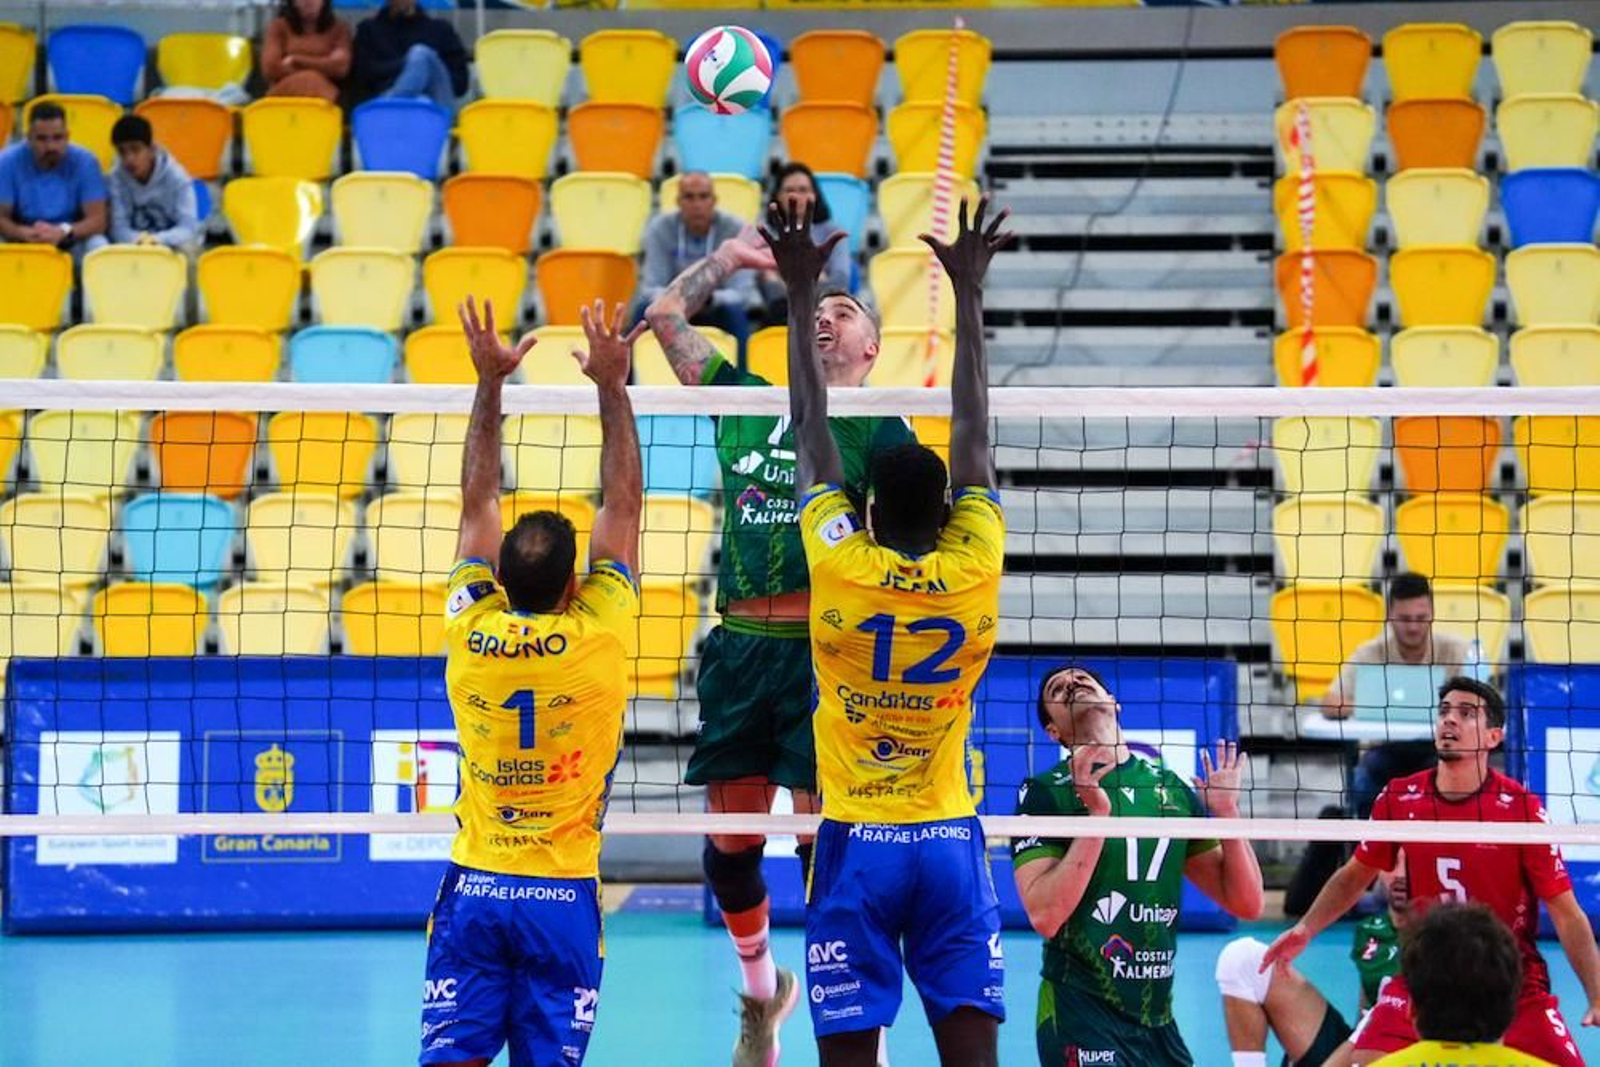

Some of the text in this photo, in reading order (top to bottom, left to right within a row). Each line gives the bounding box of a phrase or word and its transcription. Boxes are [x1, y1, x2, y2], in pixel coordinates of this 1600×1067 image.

[468, 631, 567, 659] BRUNO
[856, 613, 966, 685] 12
[501, 689, 535, 750] 1
[497, 758, 545, 774] Islas
[214, 835, 330, 853] Gran Canaria
[1126, 837, 1171, 881] 17
[1436, 857, 1466, 904] 5
